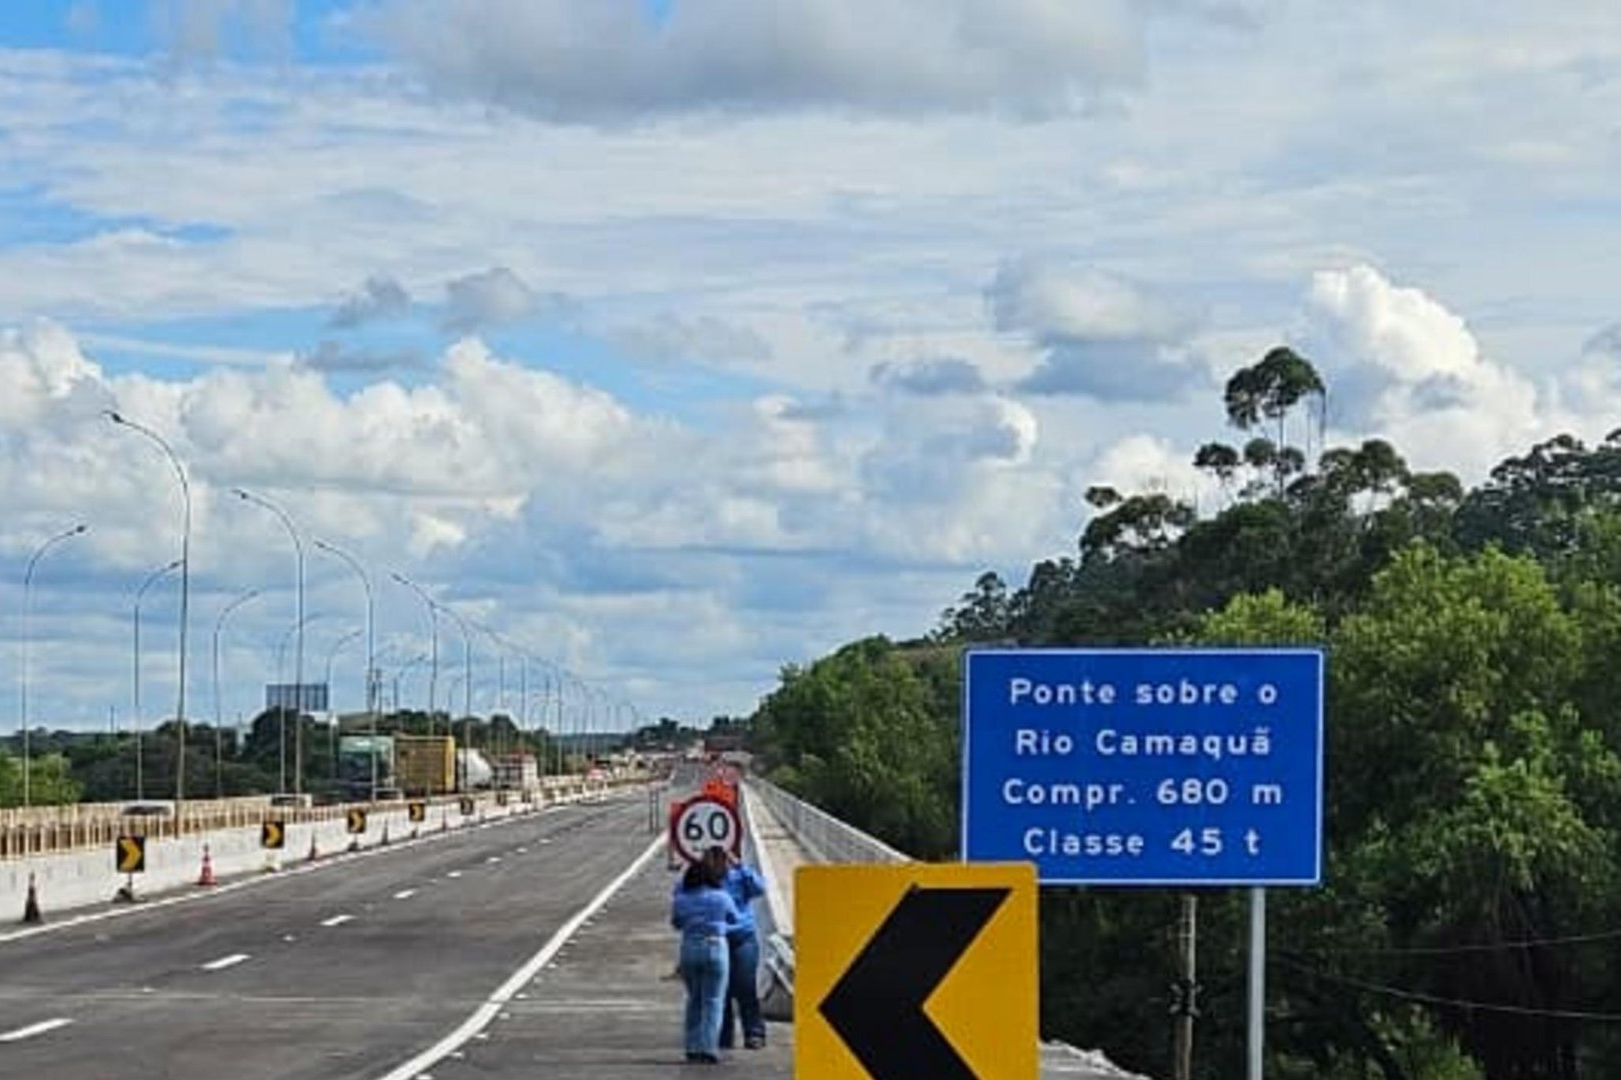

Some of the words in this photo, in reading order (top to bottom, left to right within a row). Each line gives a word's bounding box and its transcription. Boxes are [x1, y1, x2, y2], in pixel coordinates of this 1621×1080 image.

[1010, 678, 1116, 705] Ponte
[1136, 678, 1238, 704] sobre
[1258, 684, 1277, 704] o
[1015, 729, 1073, 755] Rio
[1095, 726, 1271, 760] Camaquã
[1003, 778, 1136, 810] Compr.
[1156, 778, 1228, 805] 680
[1252, 784, 1282, 804] m
[684, 811, 729, 840] 60
[1023, 828, 1145, 855] Classe
[1170, 828, 1222, 855] 45
[1244, 829, 1260, 855] t
